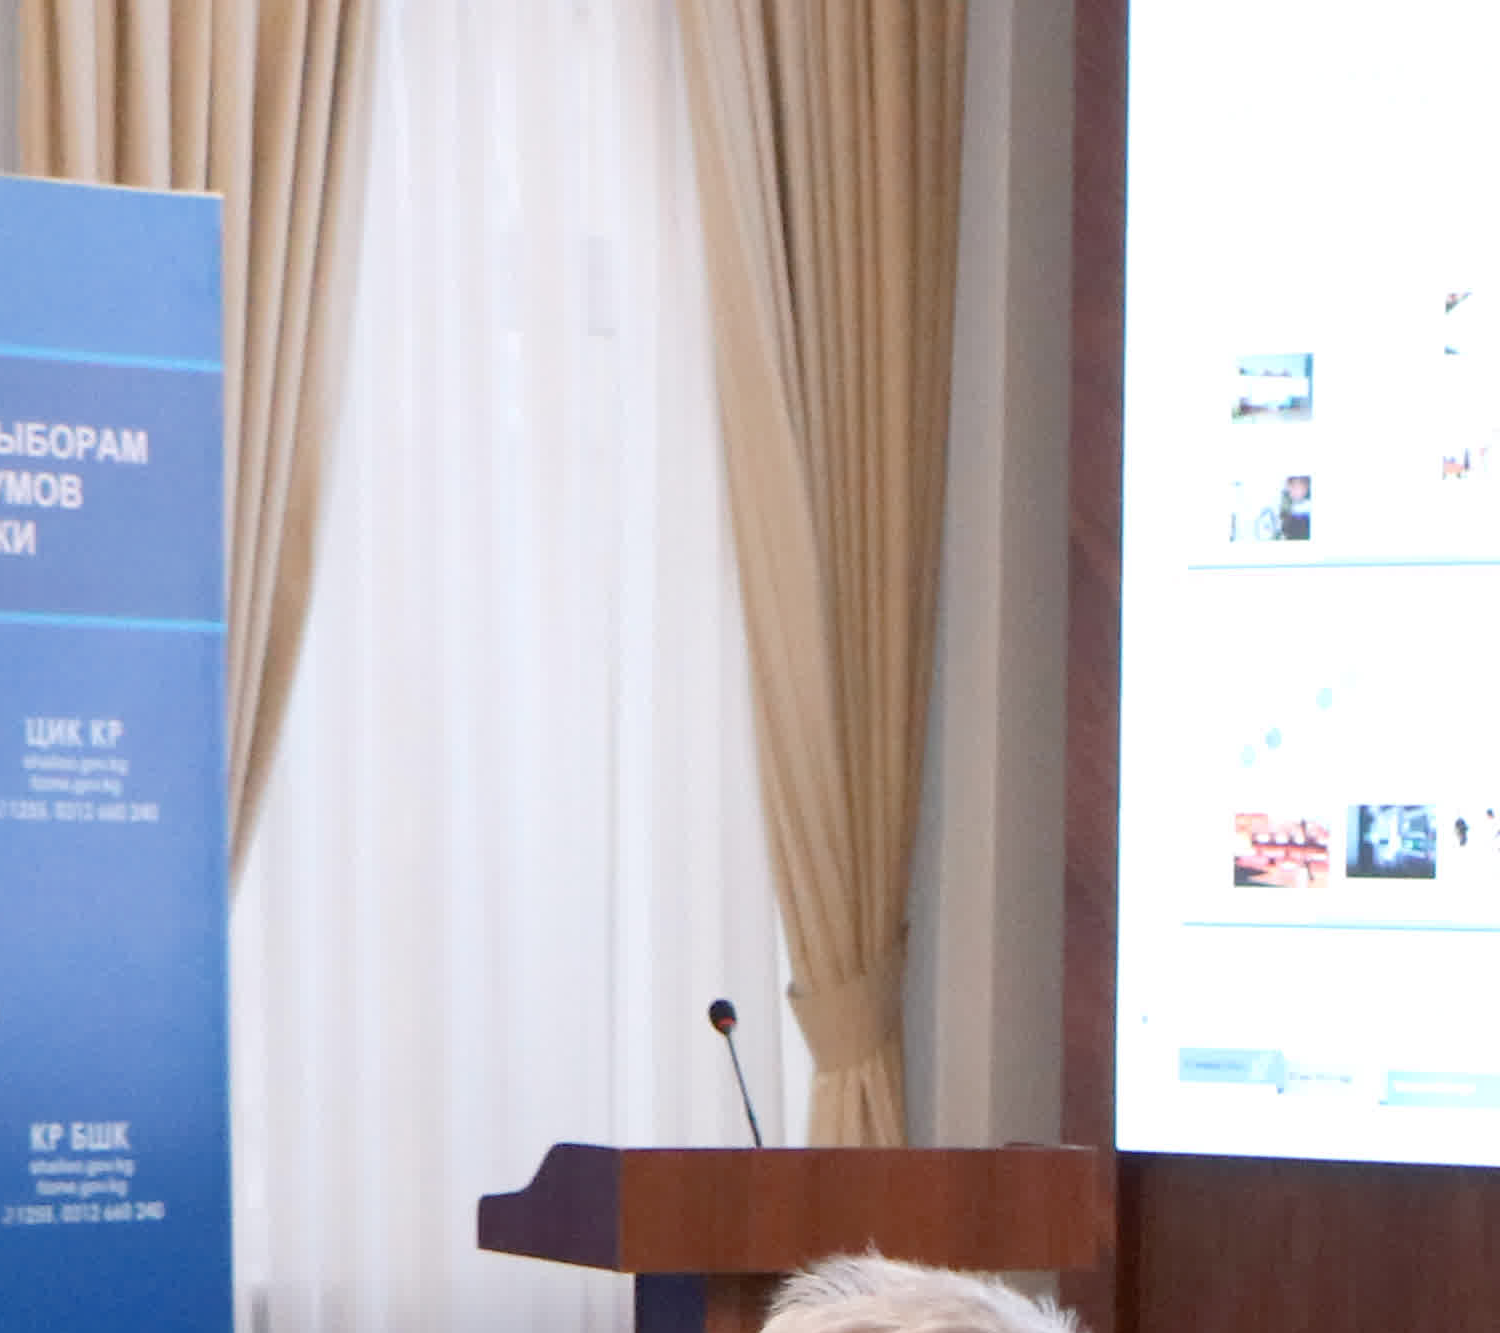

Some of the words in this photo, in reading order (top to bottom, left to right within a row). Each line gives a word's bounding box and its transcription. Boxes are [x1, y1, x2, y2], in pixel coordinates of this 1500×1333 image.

[26, 717, 84, 749] ЦИК
[90, 719, 125, 748] КР
[30, 1123, 65, 1151] КР
[71, 1122, 132, 1150] БШК
